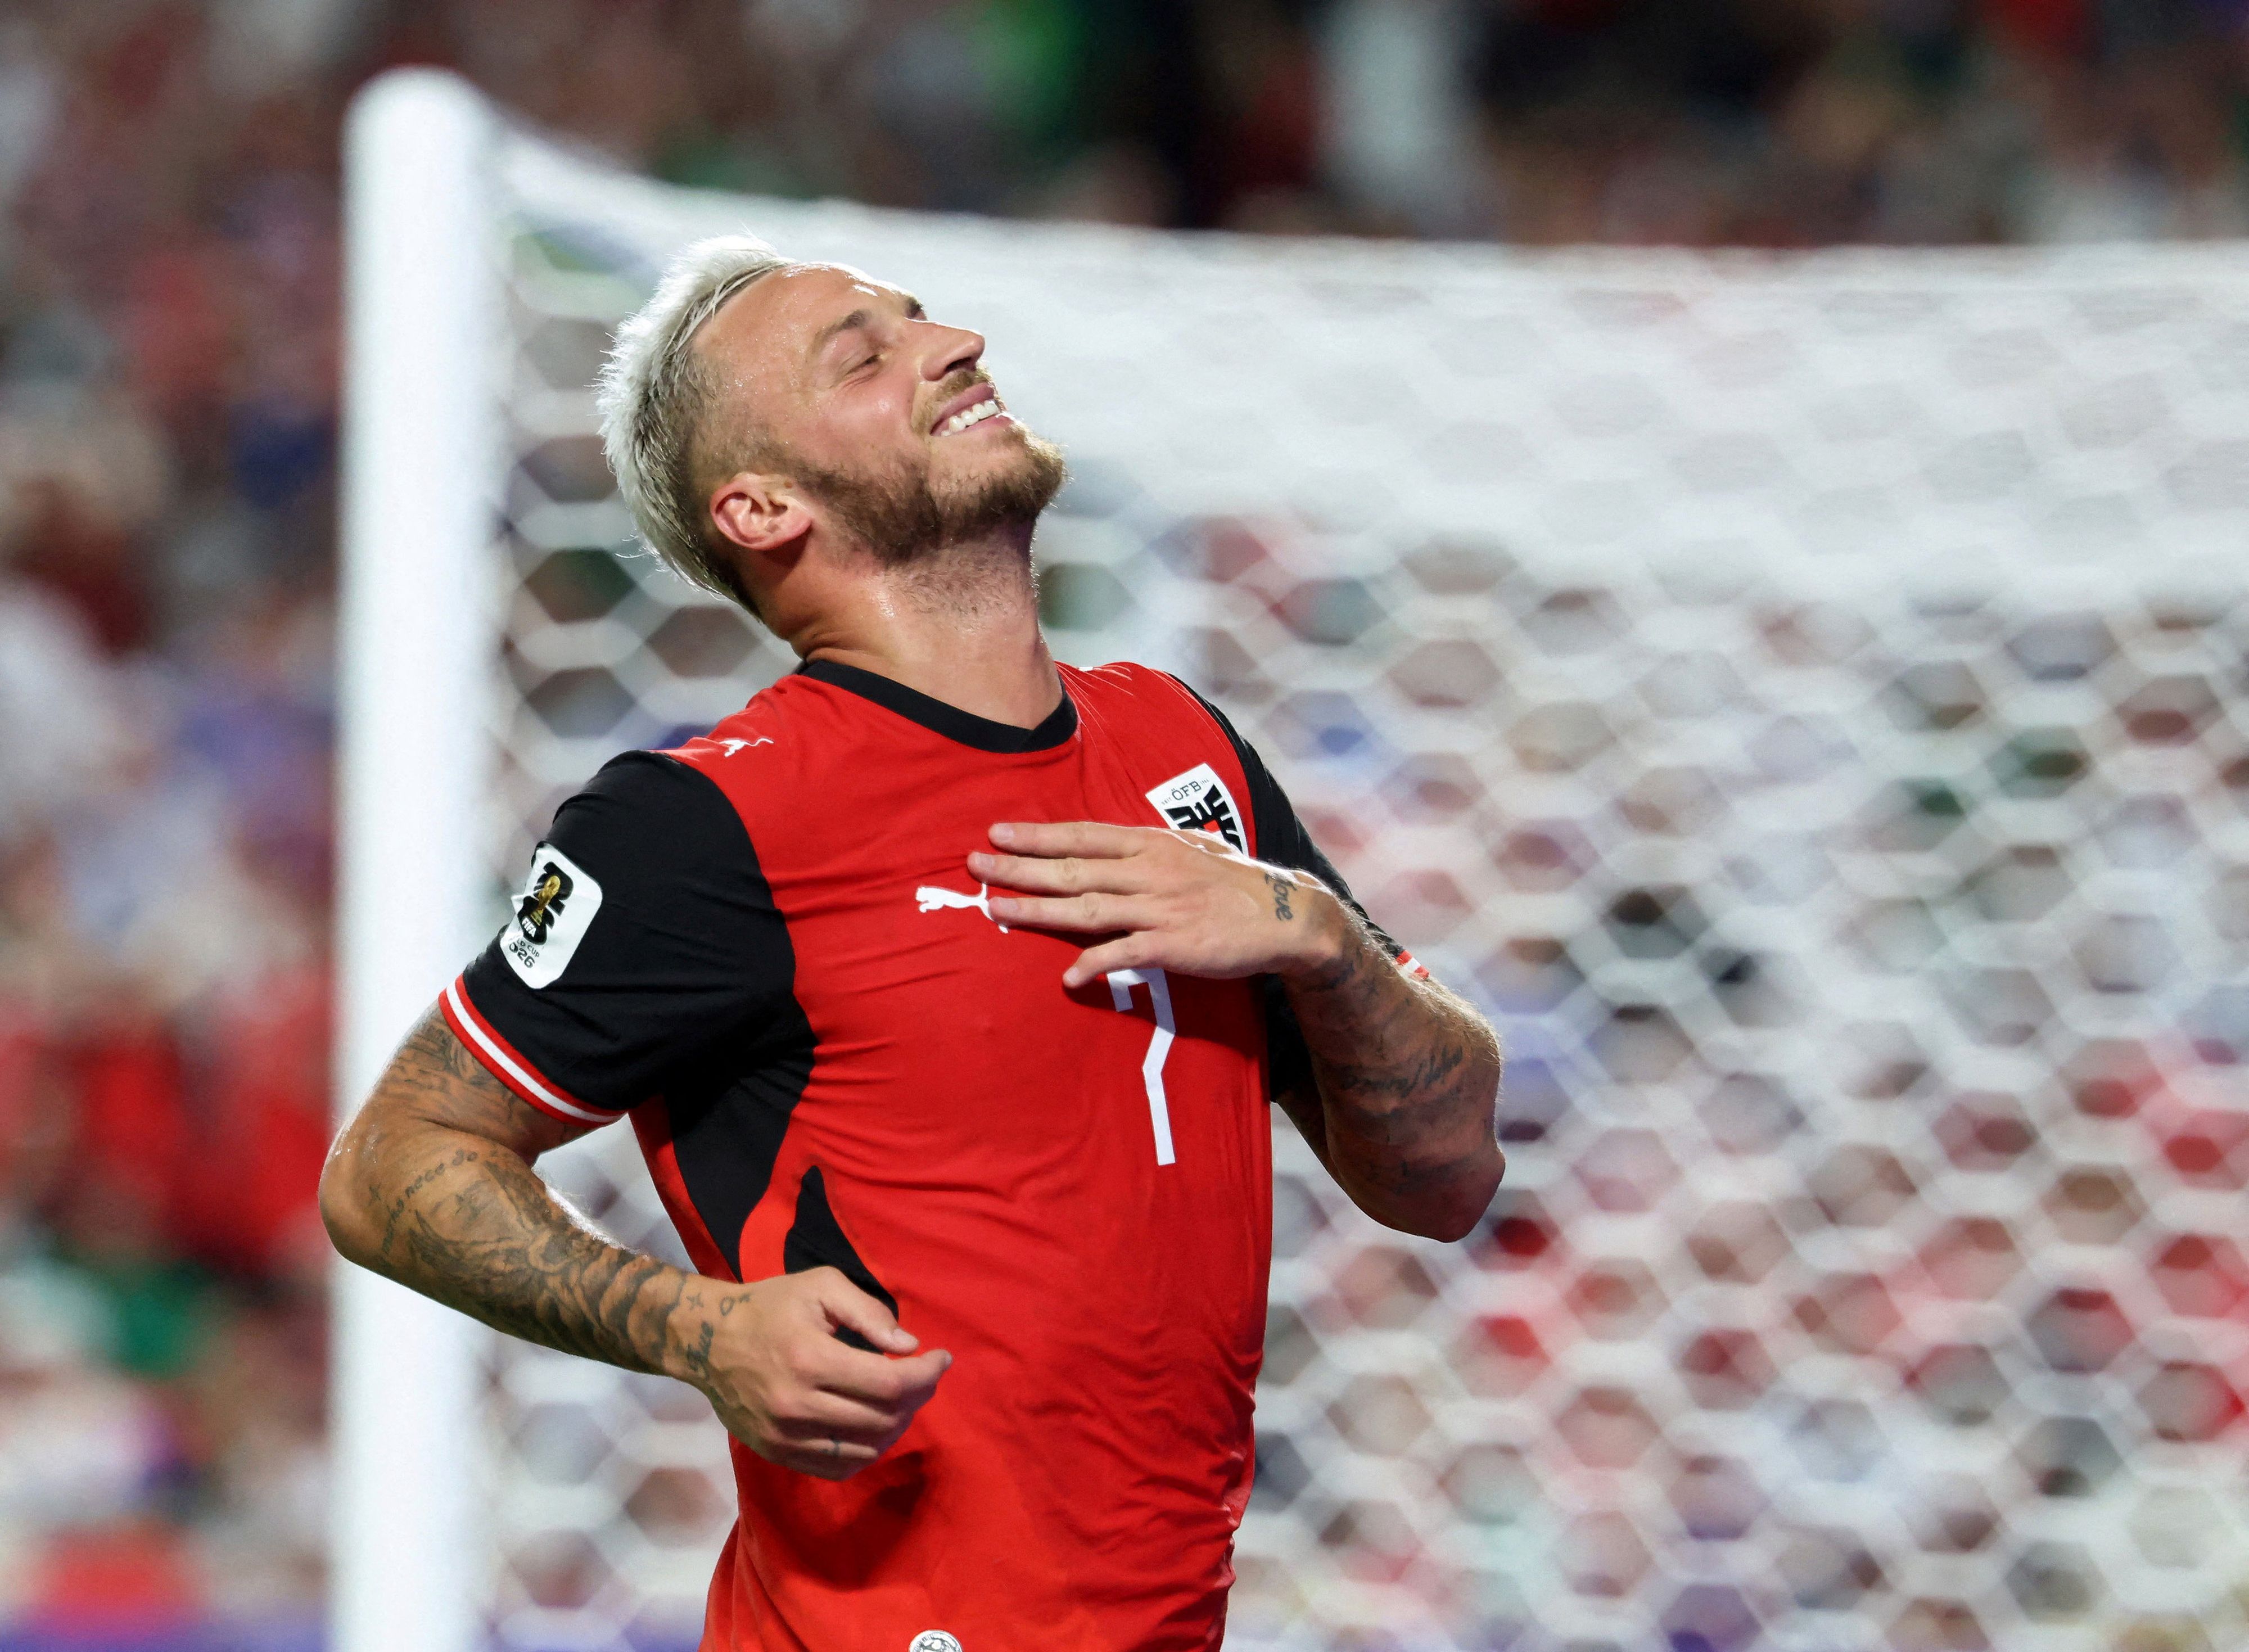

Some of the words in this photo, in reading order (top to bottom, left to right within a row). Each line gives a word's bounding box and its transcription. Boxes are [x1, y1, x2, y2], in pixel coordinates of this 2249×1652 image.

[1171, 781, 1202, 800] ÖFB
[522, 917, 537, 938] FIFA
[509, 942, 536, 968] 026
[527, 945, 540, 957] CUP
[1107, 967, 1176, 1166] 7
